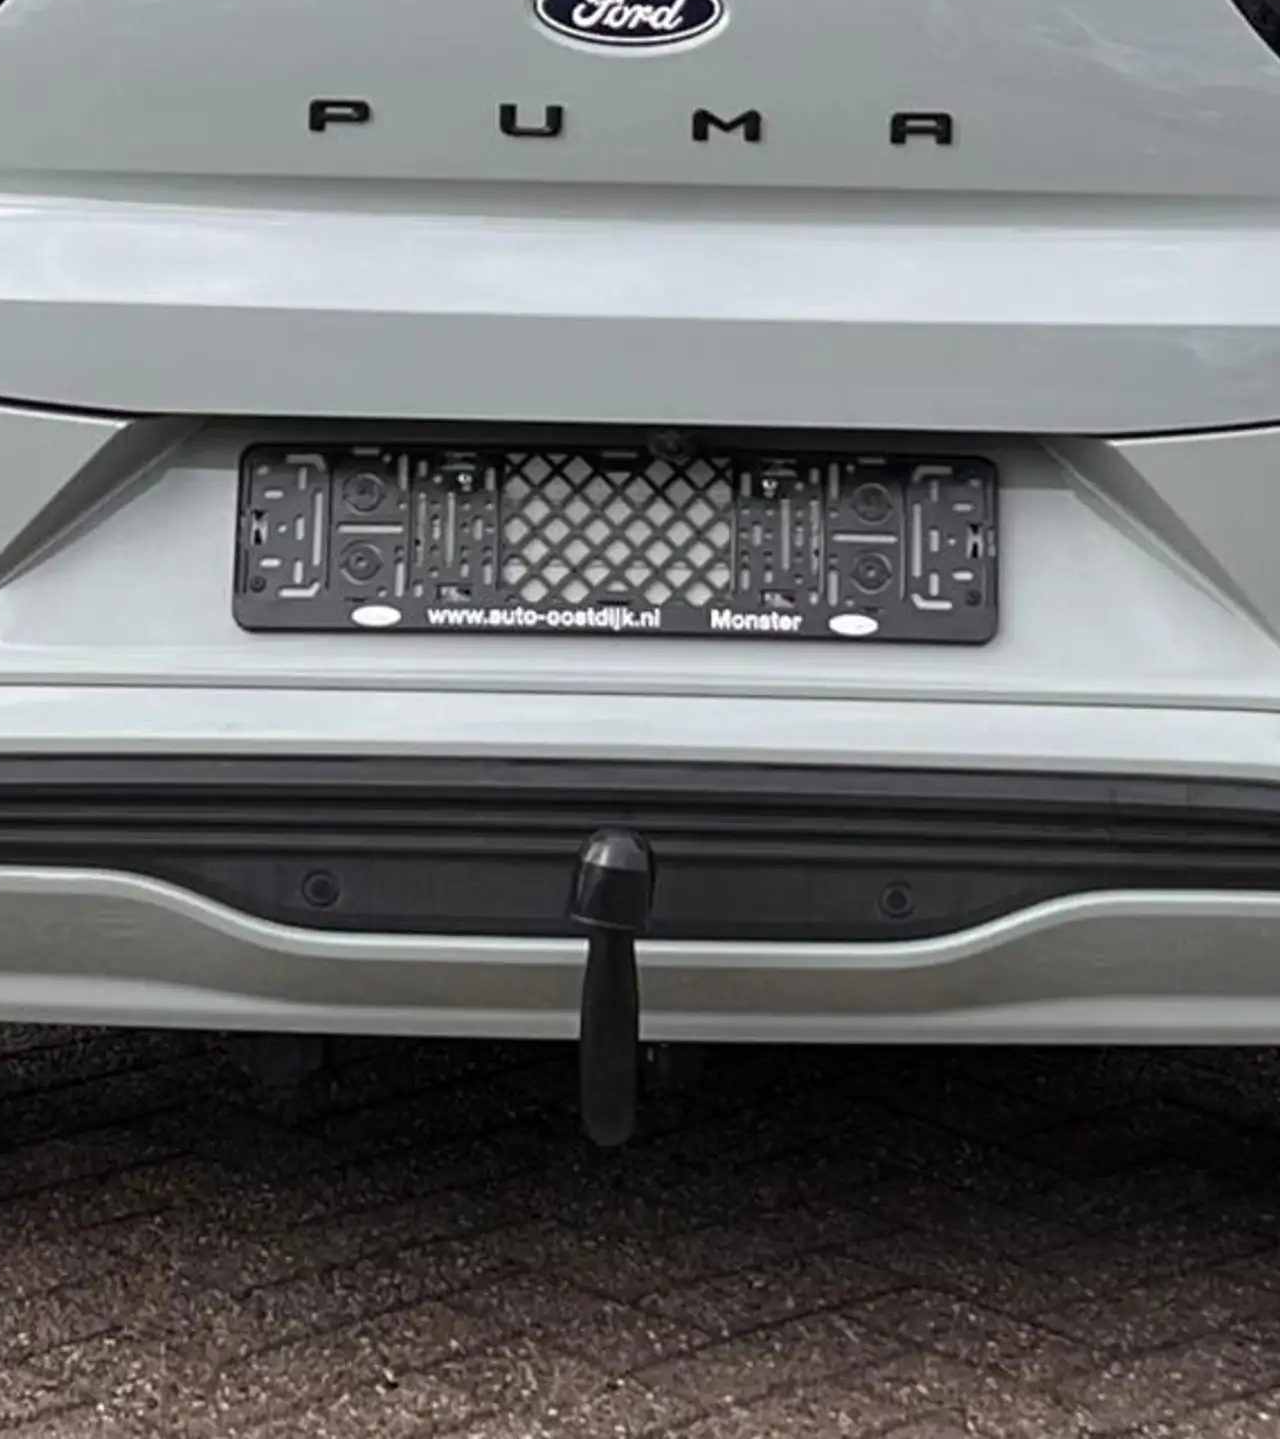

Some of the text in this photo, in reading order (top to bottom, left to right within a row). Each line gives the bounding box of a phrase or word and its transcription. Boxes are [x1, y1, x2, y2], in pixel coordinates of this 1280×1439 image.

[308, 98, 953, 146] PUMA
[428, 606, 802, 631] www.auto-oostdijk.nl Monster
